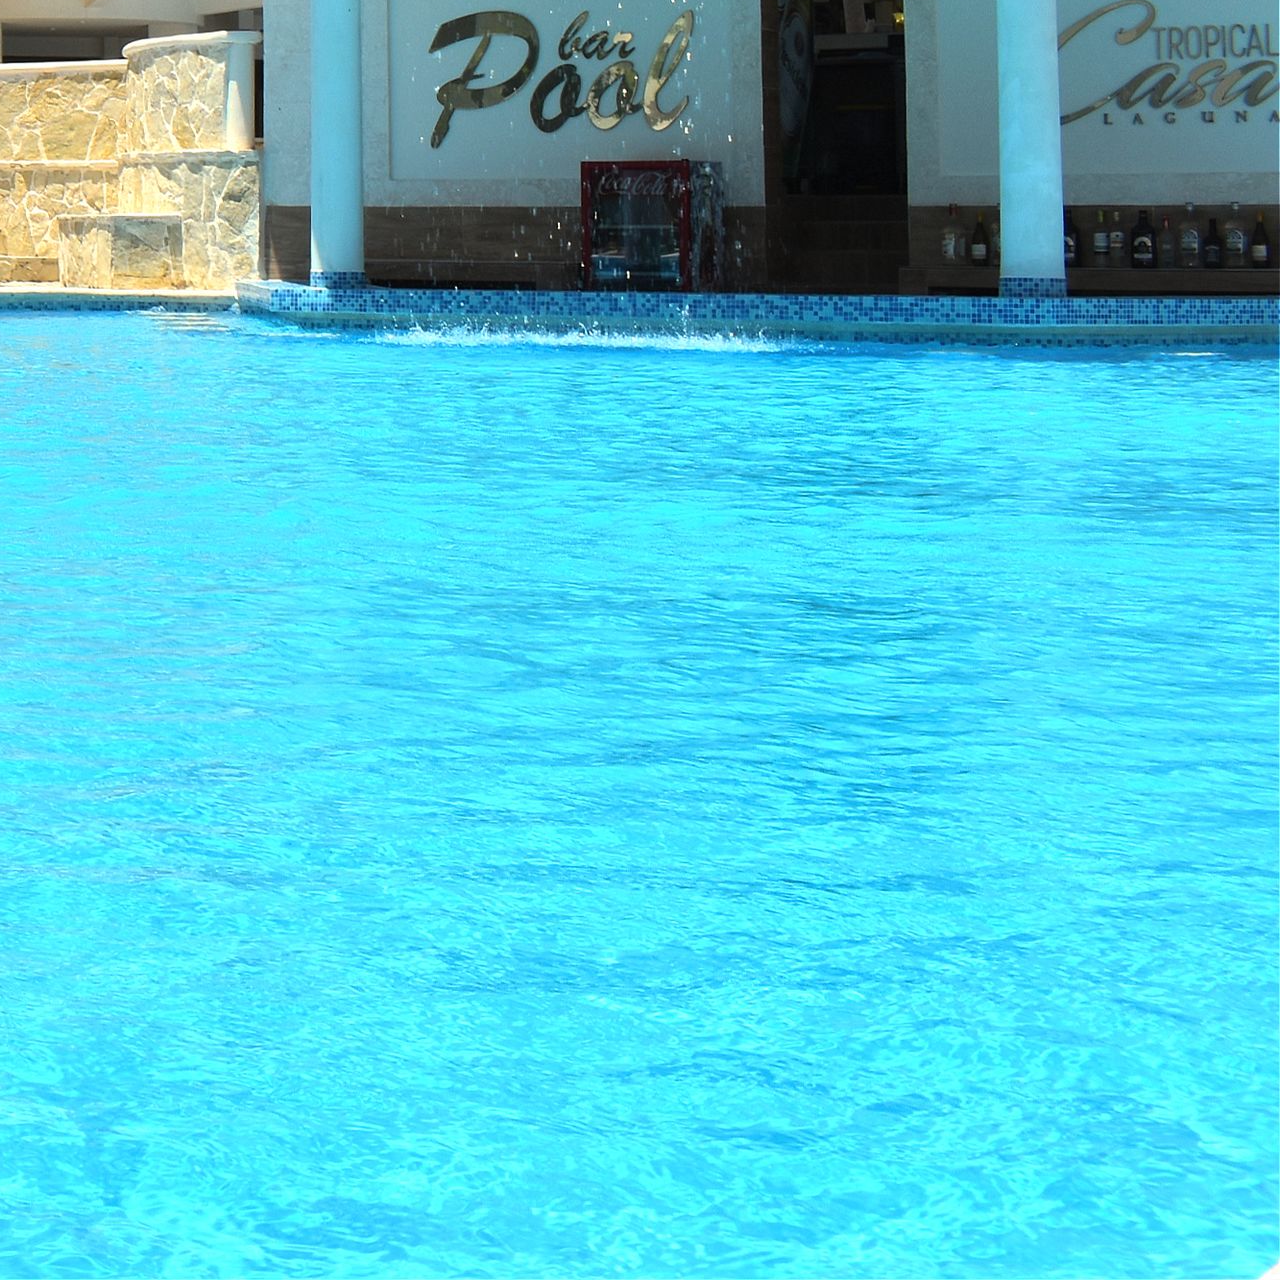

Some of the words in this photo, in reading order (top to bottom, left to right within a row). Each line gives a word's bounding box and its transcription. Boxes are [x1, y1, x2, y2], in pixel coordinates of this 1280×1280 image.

[558, 10, 636, 61] bar
[1151, 23, 1279, 60] TROPICAL
[428, 10, 695, 149] Pool
[1103, 110, 1279, 126] LAGUNA
